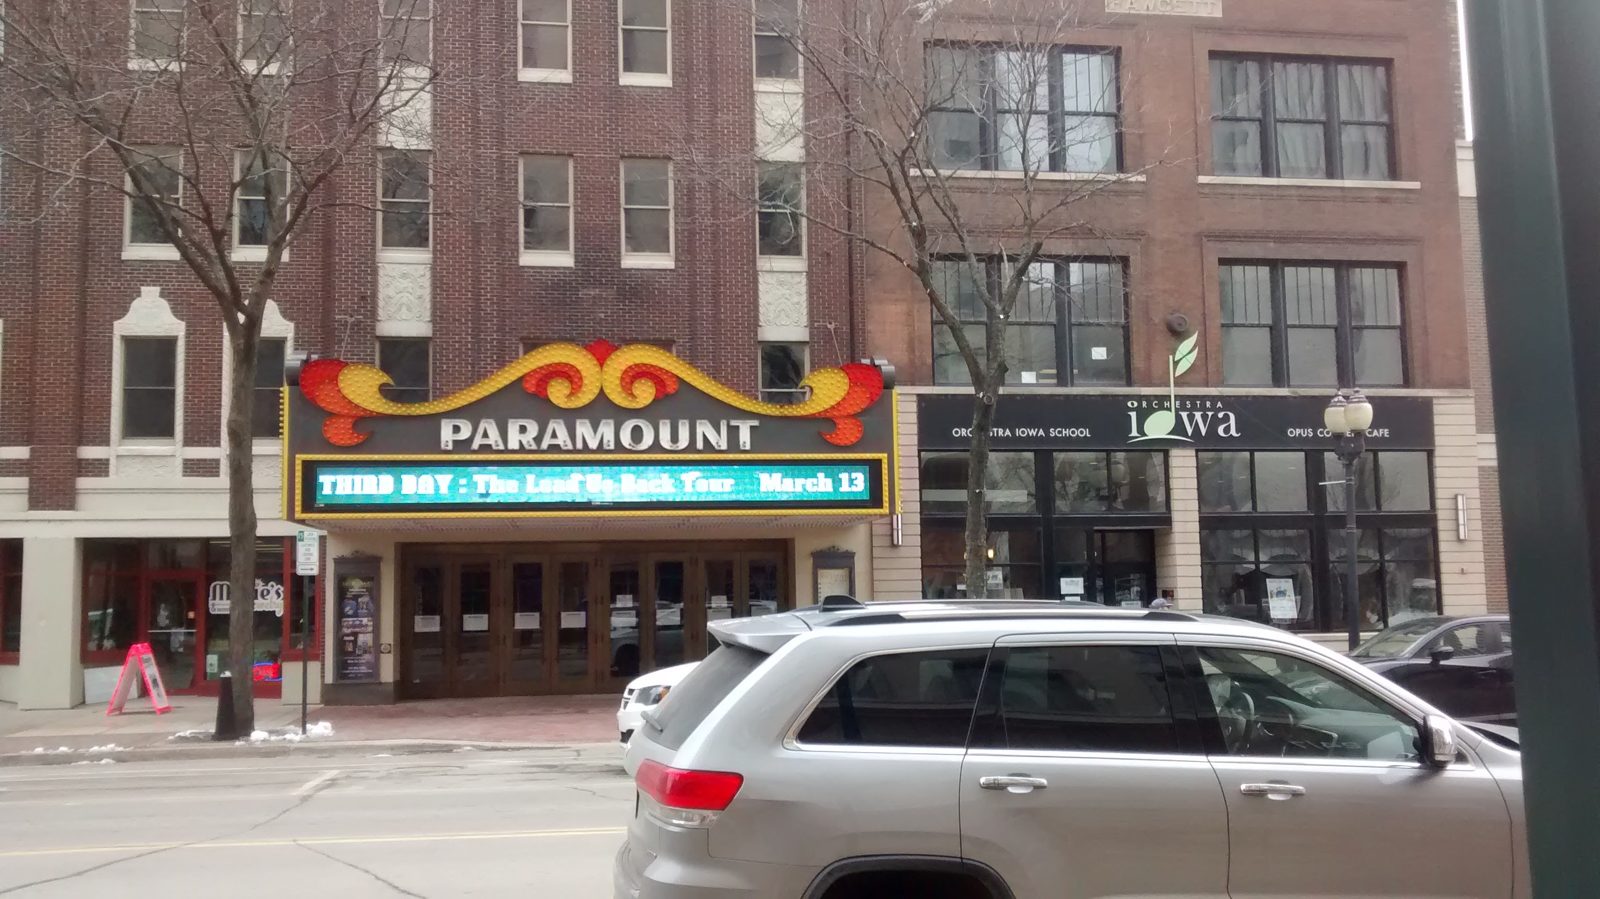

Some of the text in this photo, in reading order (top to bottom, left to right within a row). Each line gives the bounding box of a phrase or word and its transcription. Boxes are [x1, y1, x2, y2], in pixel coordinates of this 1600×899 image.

[440, 418, 760, 450] PARAMOUNT
[952, 427, 1091, 437] ORCTRA IOWA SCHOOL
[1287, 428, 1313, 437] OPUS
[1366, 429, 1389, 437] CAFE
[319, 474, 394, 495] THIRD
[401, 474, 453, 495] DAY
[681, 471, 735, 493] Tour
[758, 472, 833, 493] March
[839, 472, 865, 493] 13
